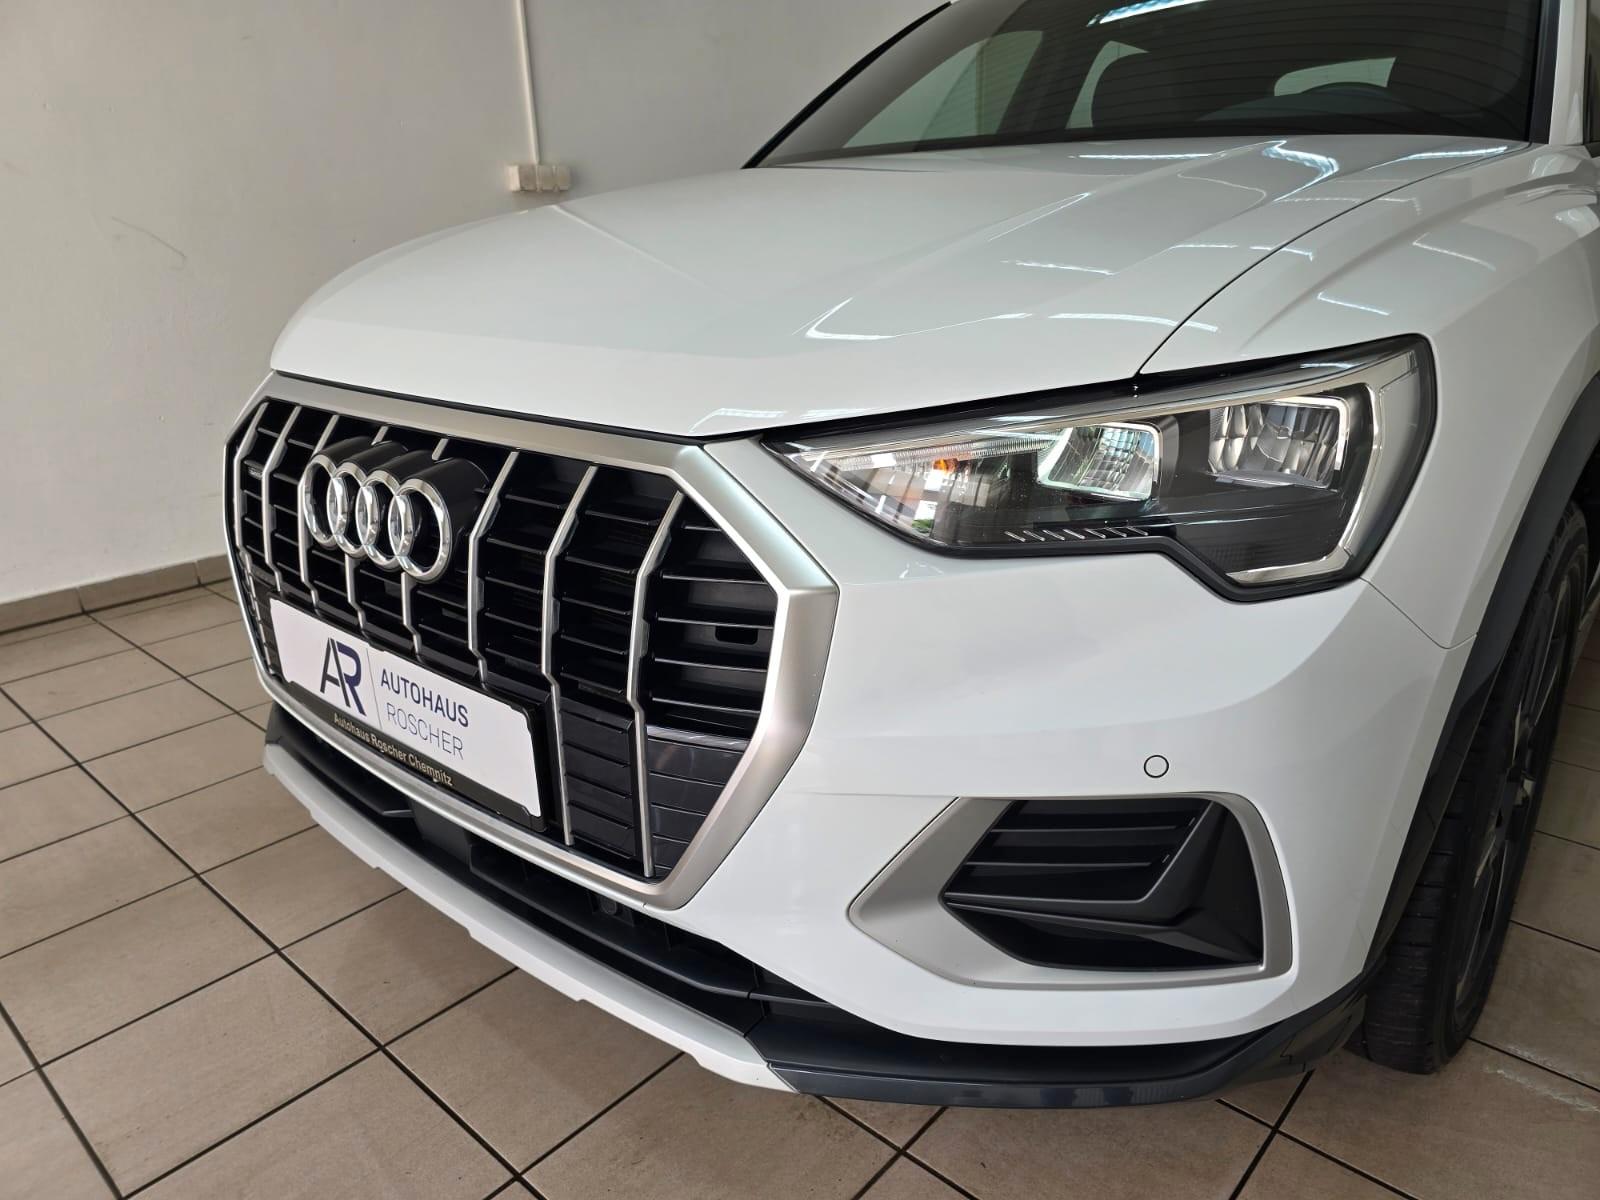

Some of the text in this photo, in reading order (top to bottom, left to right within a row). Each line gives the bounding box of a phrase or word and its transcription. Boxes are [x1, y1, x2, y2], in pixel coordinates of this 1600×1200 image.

[320, 637, 367, 717] AR
[380, 668, 469, 728] AUTOHAUS
[334, 712, 453, 786] Autohaus Roscher Chemnitz
[386, 702, 464, 760] ROSCHER
